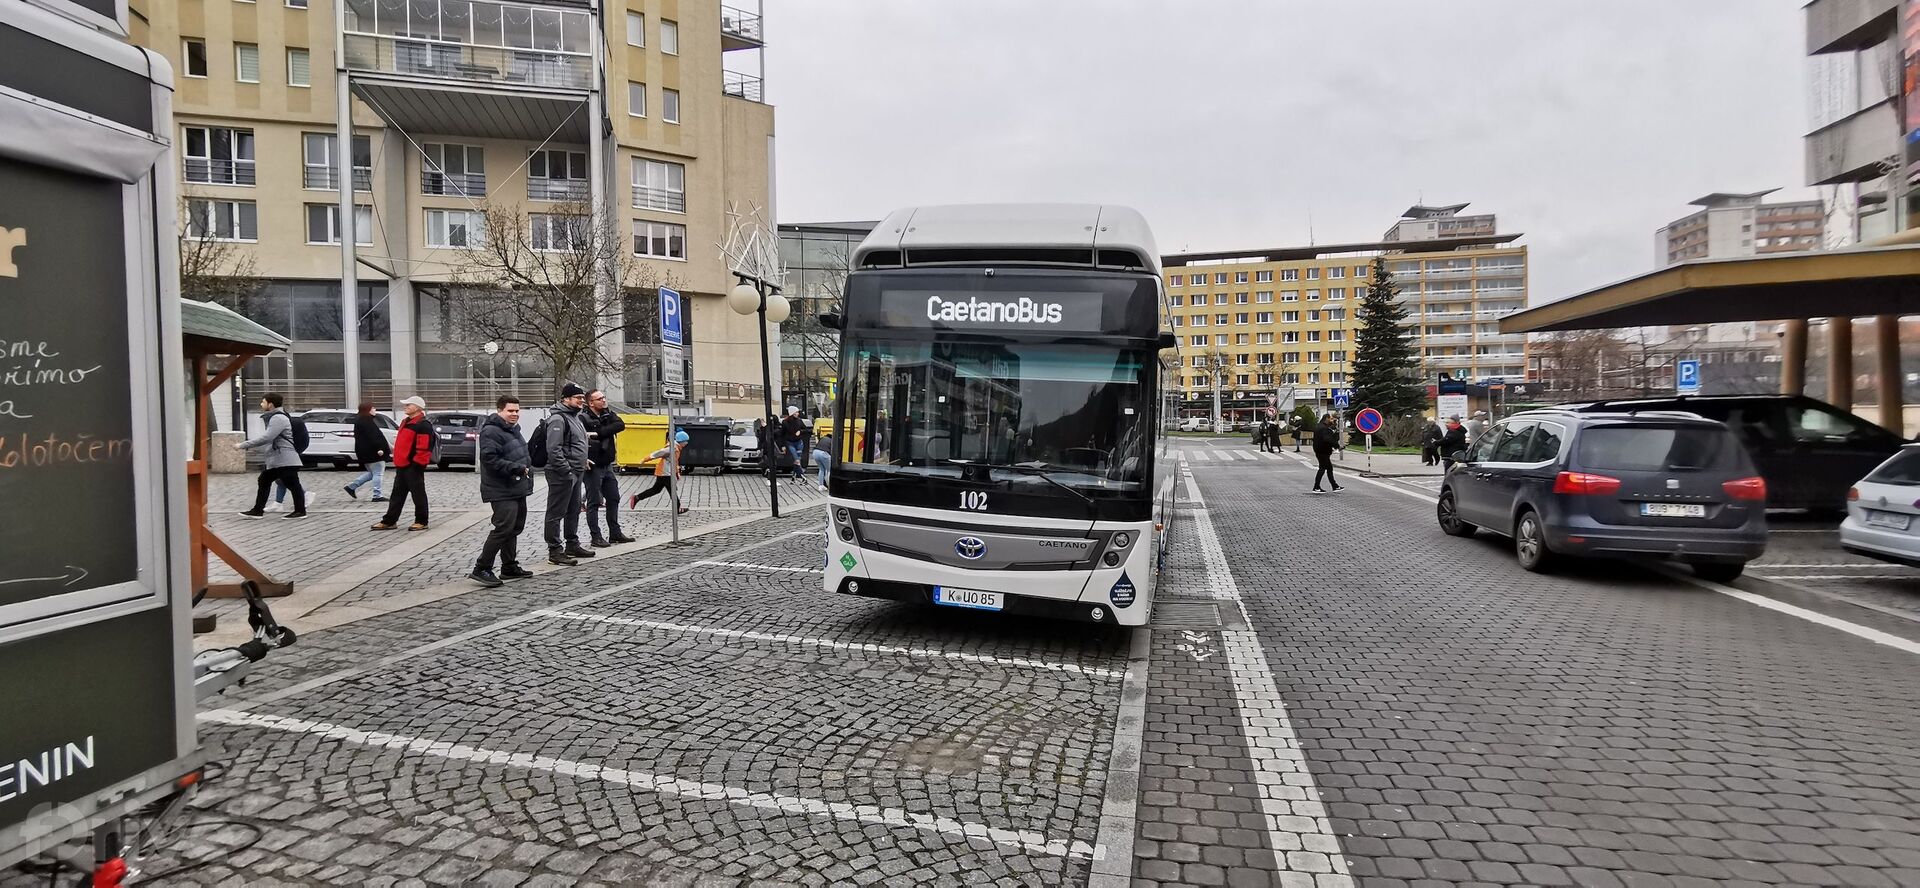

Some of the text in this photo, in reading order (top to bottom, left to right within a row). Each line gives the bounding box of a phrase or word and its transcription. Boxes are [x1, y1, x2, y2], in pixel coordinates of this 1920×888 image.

[664, 295, 677, 326] P
[927, 295, 1063, 323] CaetanoBus
[1681, 363, 1695, 382] P
[959, 490, 988, 511] 102
[1038, 540, 1088, 549] CAETANO
[948, 590, 956, 602] K
[981, 593, 995, 606] 85
